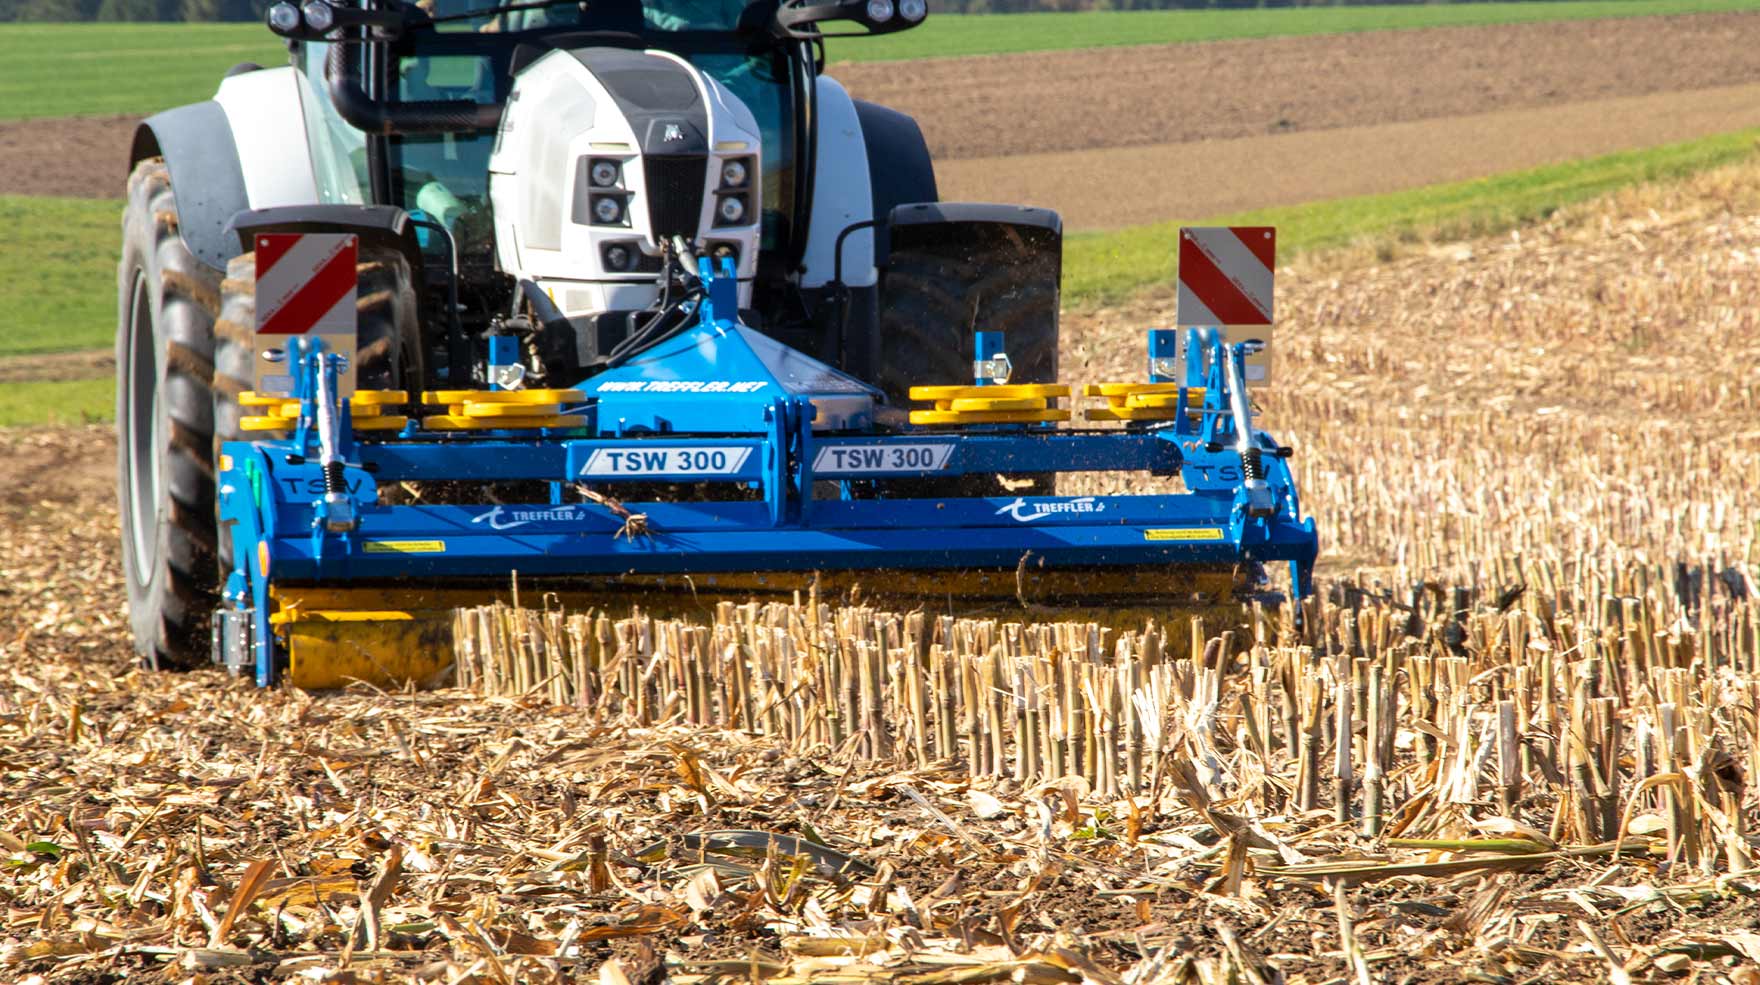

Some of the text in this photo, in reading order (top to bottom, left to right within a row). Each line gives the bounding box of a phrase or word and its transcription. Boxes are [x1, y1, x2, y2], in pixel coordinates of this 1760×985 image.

[597, 381, 768, 392] WWW.TREFFLER.NET
[607, 451, 726, 471] TSW 300
[832, 448, 934, 468] TSW 300
[1033, 502, 1094, 512] TREFFLER
[511, 511, 573, 521] TREFFLER
